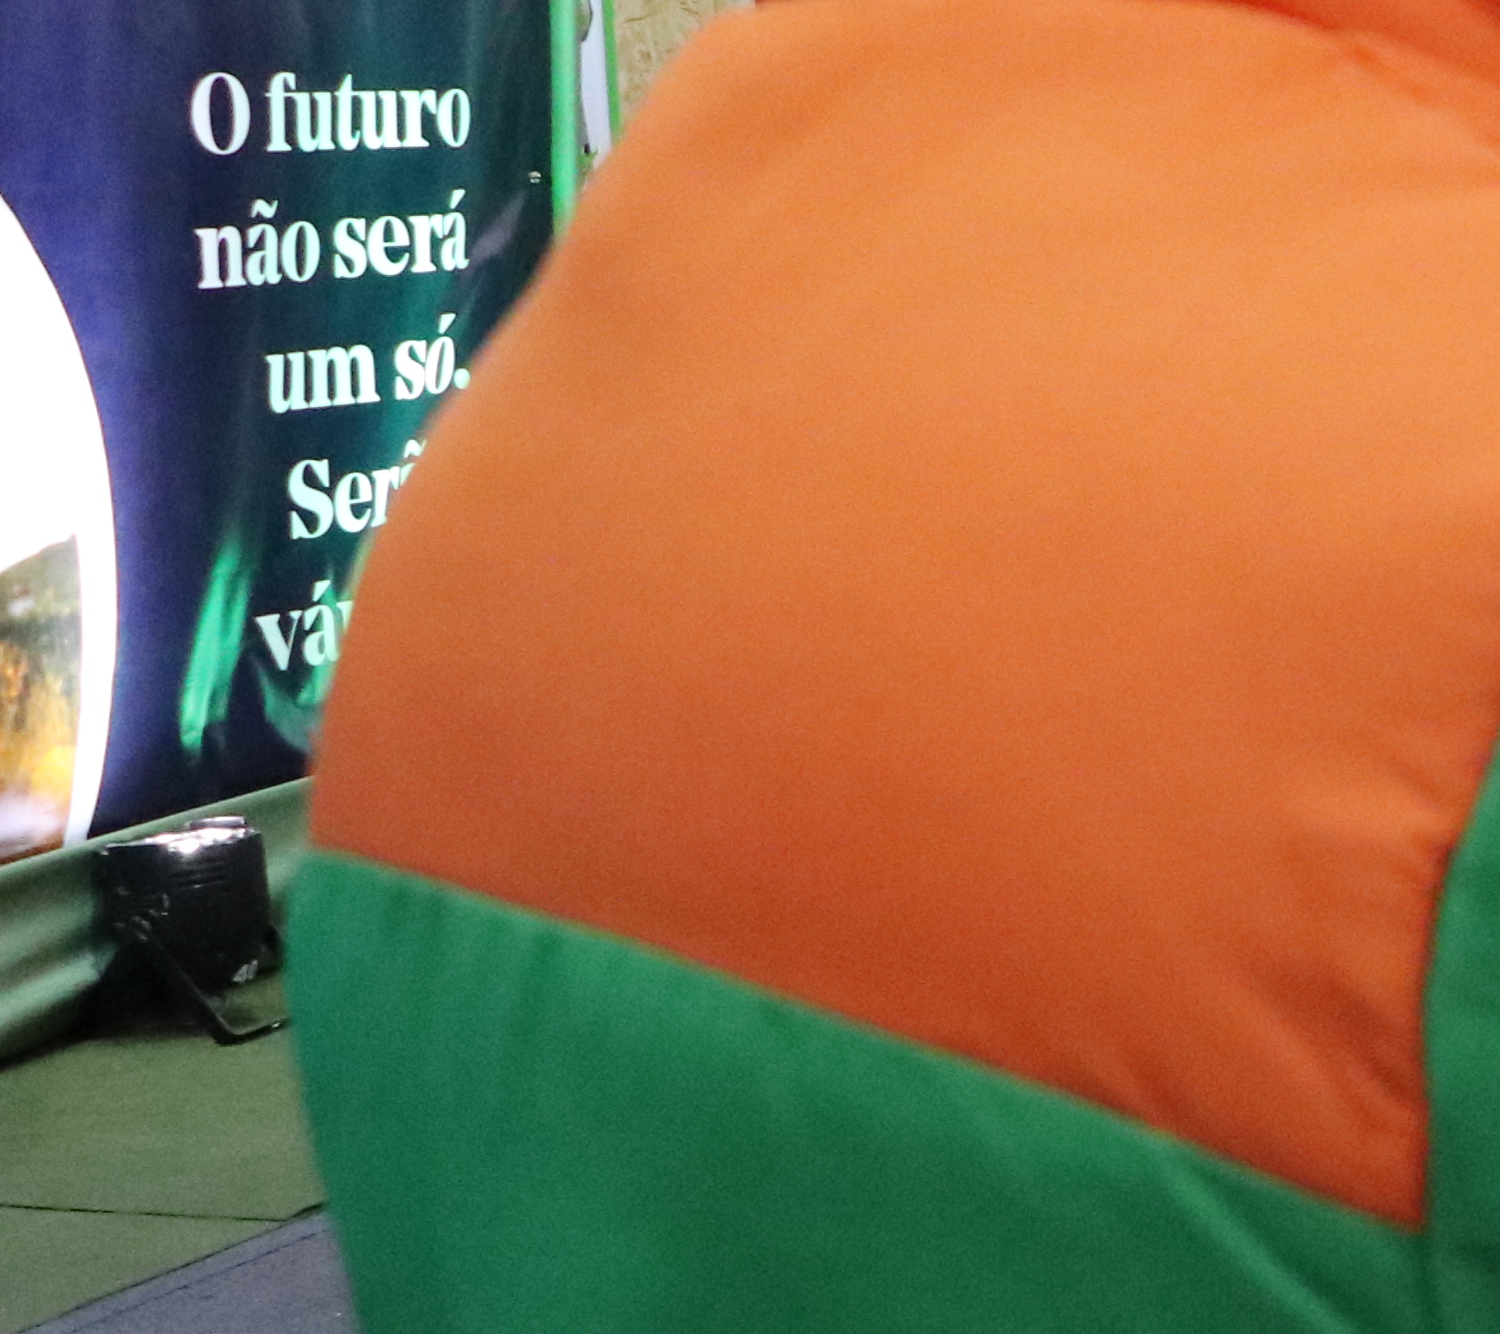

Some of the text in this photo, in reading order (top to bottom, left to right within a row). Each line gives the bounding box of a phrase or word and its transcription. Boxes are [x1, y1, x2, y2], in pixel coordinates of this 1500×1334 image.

[191, 71, 472, 156] O futuro
[194, 189, 470, 289] não será
[266, 313, 471, 414] um só.
